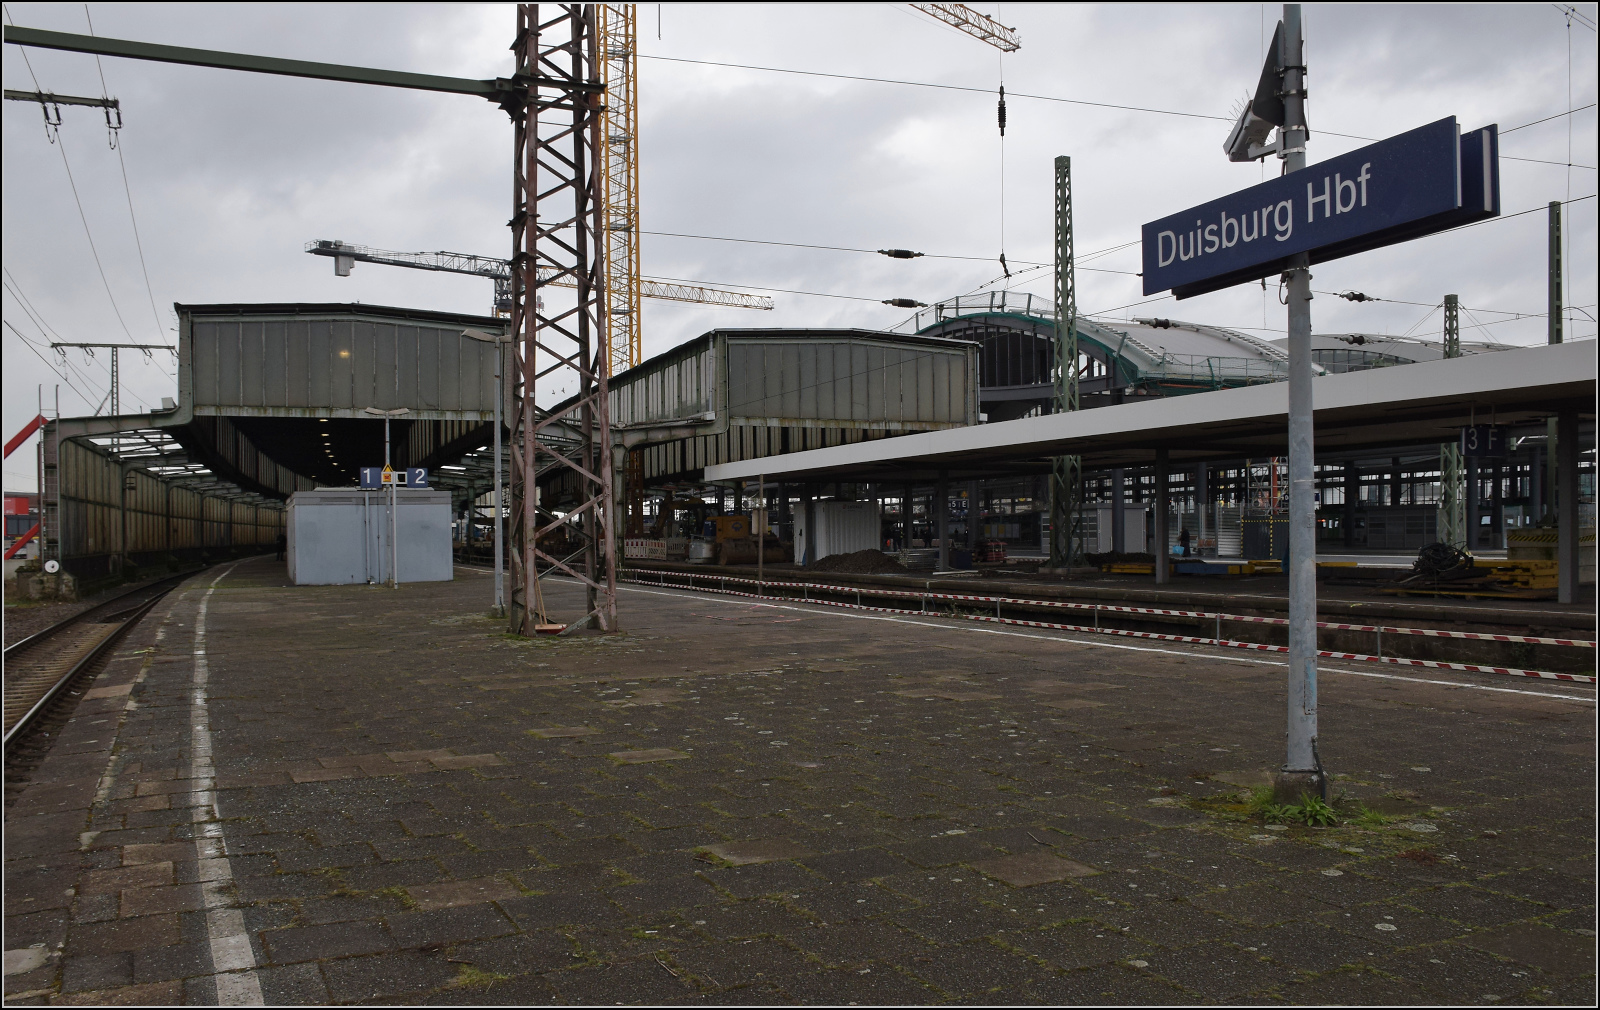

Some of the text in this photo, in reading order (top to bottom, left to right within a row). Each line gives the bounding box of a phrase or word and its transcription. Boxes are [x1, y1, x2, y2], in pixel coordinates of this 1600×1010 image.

[1157, 162, 1371, 268] Duisburg Hbf
[1468, 428, 1498, 450] 3 F
[363, 468, 371, 484] 1
[415, 468, 426, 484] 2
